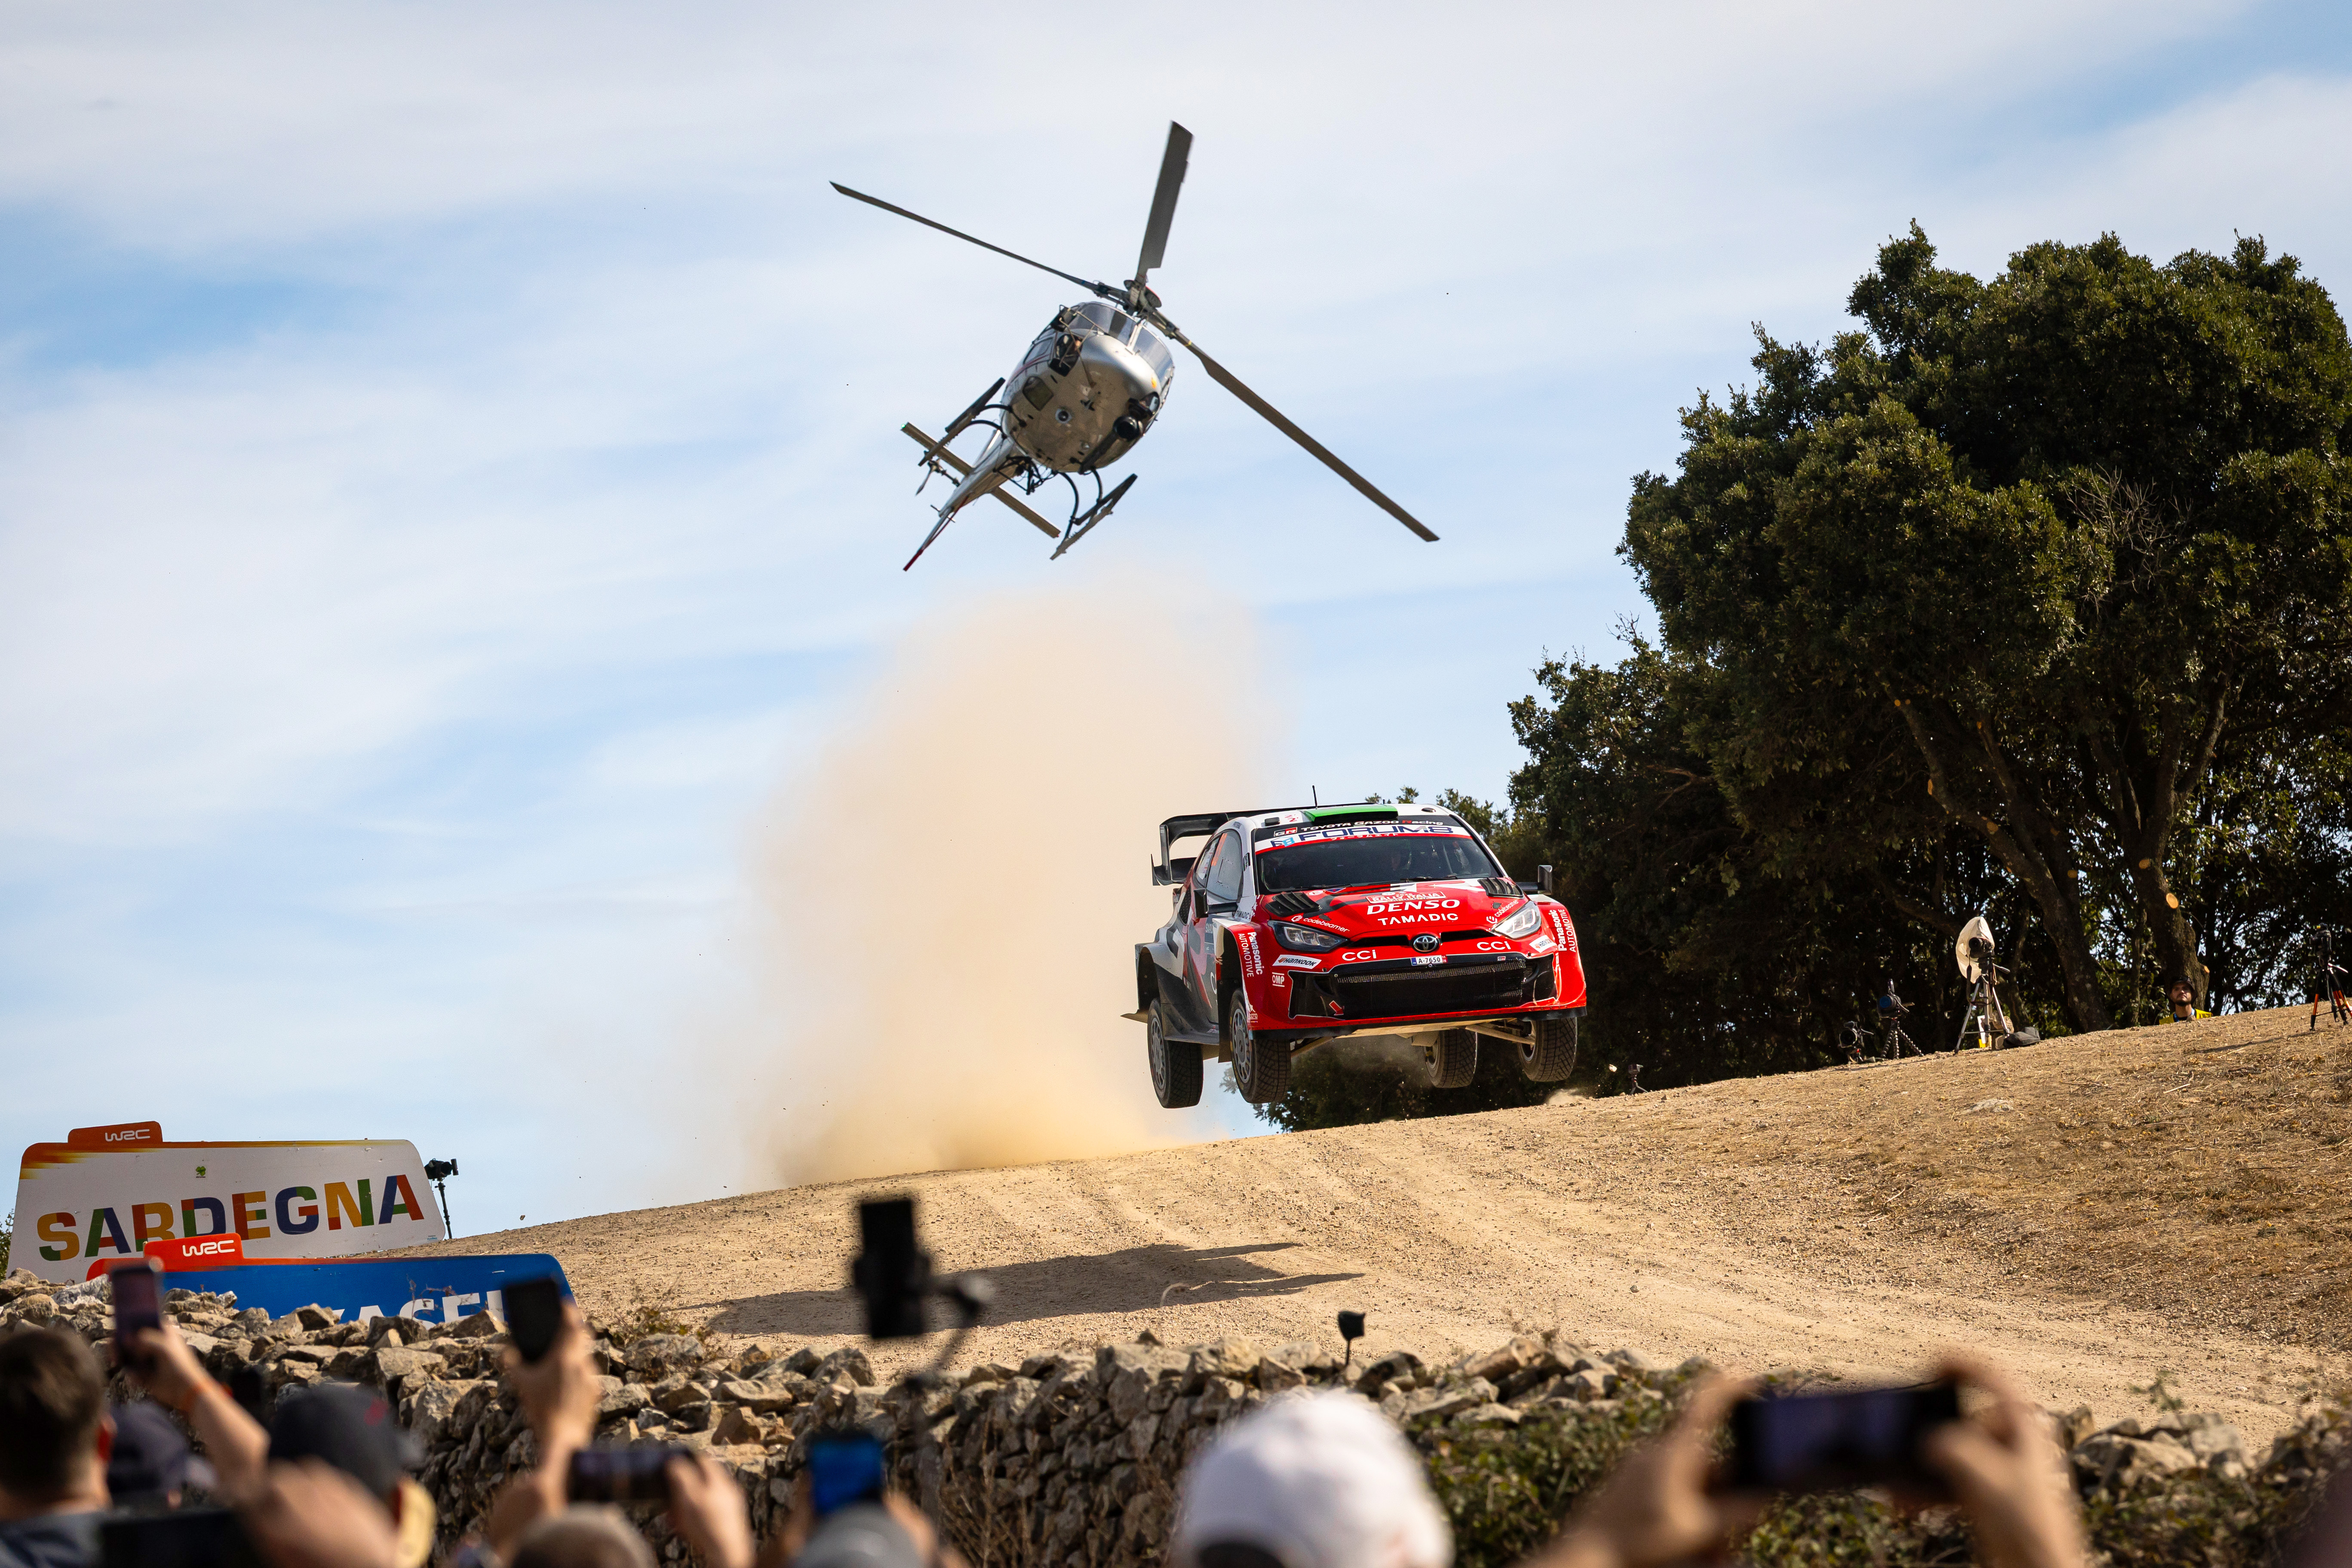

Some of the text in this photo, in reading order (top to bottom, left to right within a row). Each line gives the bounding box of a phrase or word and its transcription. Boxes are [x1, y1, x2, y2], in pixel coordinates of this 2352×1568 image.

[1298, 825, 1454, 841] FORUM8
[1301, 822, 1351, 831] TOYOTA
[1366, 899, 1460, 915] DENSO
[1303, 917, 1350, 933] codebeamer
[1377, 913, 1459, 926] TAMADIC
[1548, 909, 1567, 951] Panasonic
[1557, 909, 1576, 952] AUTOMOTIVE
[1238, 933, 1254, 978] AUTOMOTIVE
[1247, 931, 1265, 975] Panasonic
[1272, 974, 1285, 985] OMP
[104, 1128, 150, 1142] WRC
[37, 1174, 425, 1261] SARDEGNA
[182, 1240, 236, 1257] WRC
